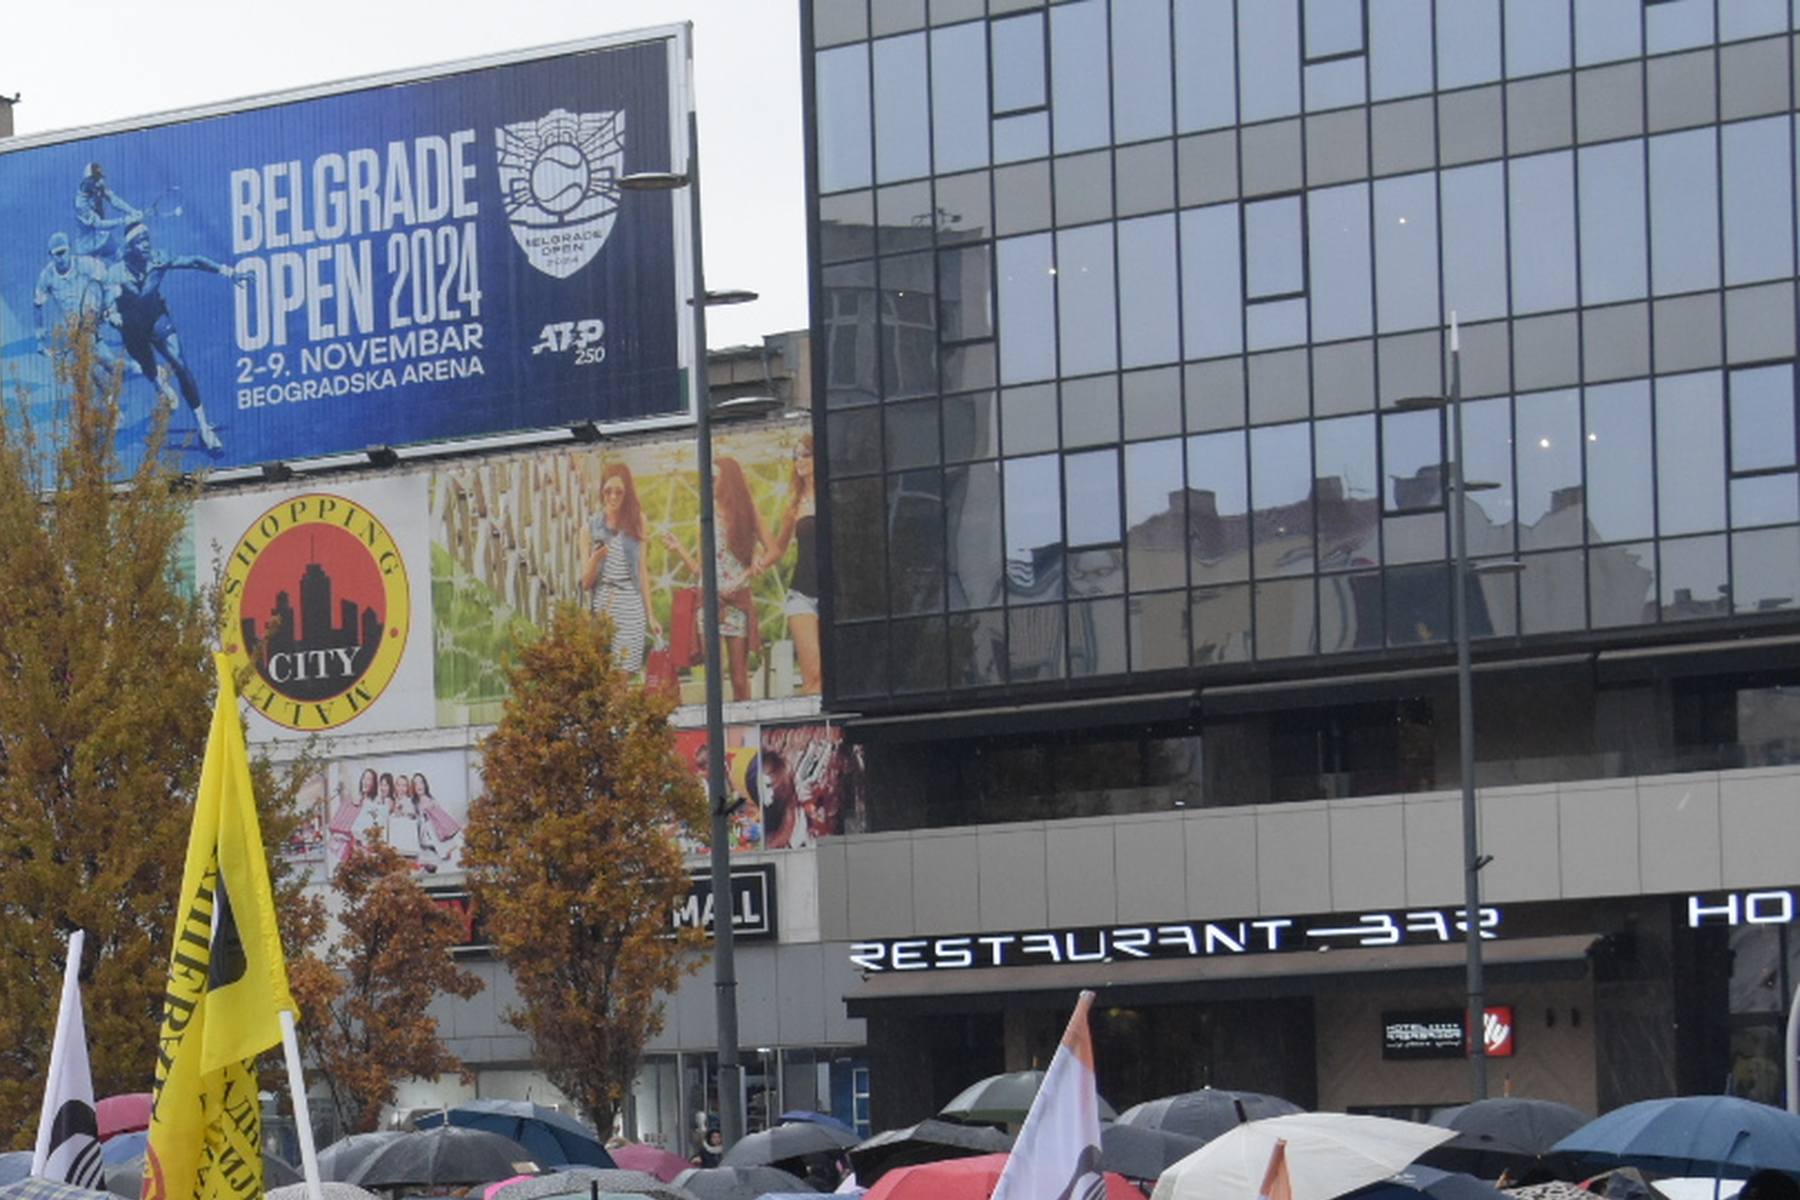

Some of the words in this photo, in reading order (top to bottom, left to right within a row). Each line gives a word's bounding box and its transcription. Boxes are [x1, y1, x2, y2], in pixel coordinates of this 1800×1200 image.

[231, 129, 478, 255] BELGRADE
[542, 242, 583, 256] OPEN
[234, 239, 374, 352] OPEN
[388, 222, 482, 329] 2024
[301, 323, 484, 375] NOVEMBAR
[532, 319, 604, 355] ATP
[575, 347, 605, 365] 250
[238, 368, 397, 409] BEOGRADSKA
[402, 356, 485, 385] ARENA
[224, 499, 399, 598] SHOPPING
[269, 646, 362, 683] CITY
[250, 680, 372, 725] MALL
[673, 890, 760, 928] MAL
[1688, 891, 1792, 927] HO
[850, 920, 1291, 970] RESTAURANT
